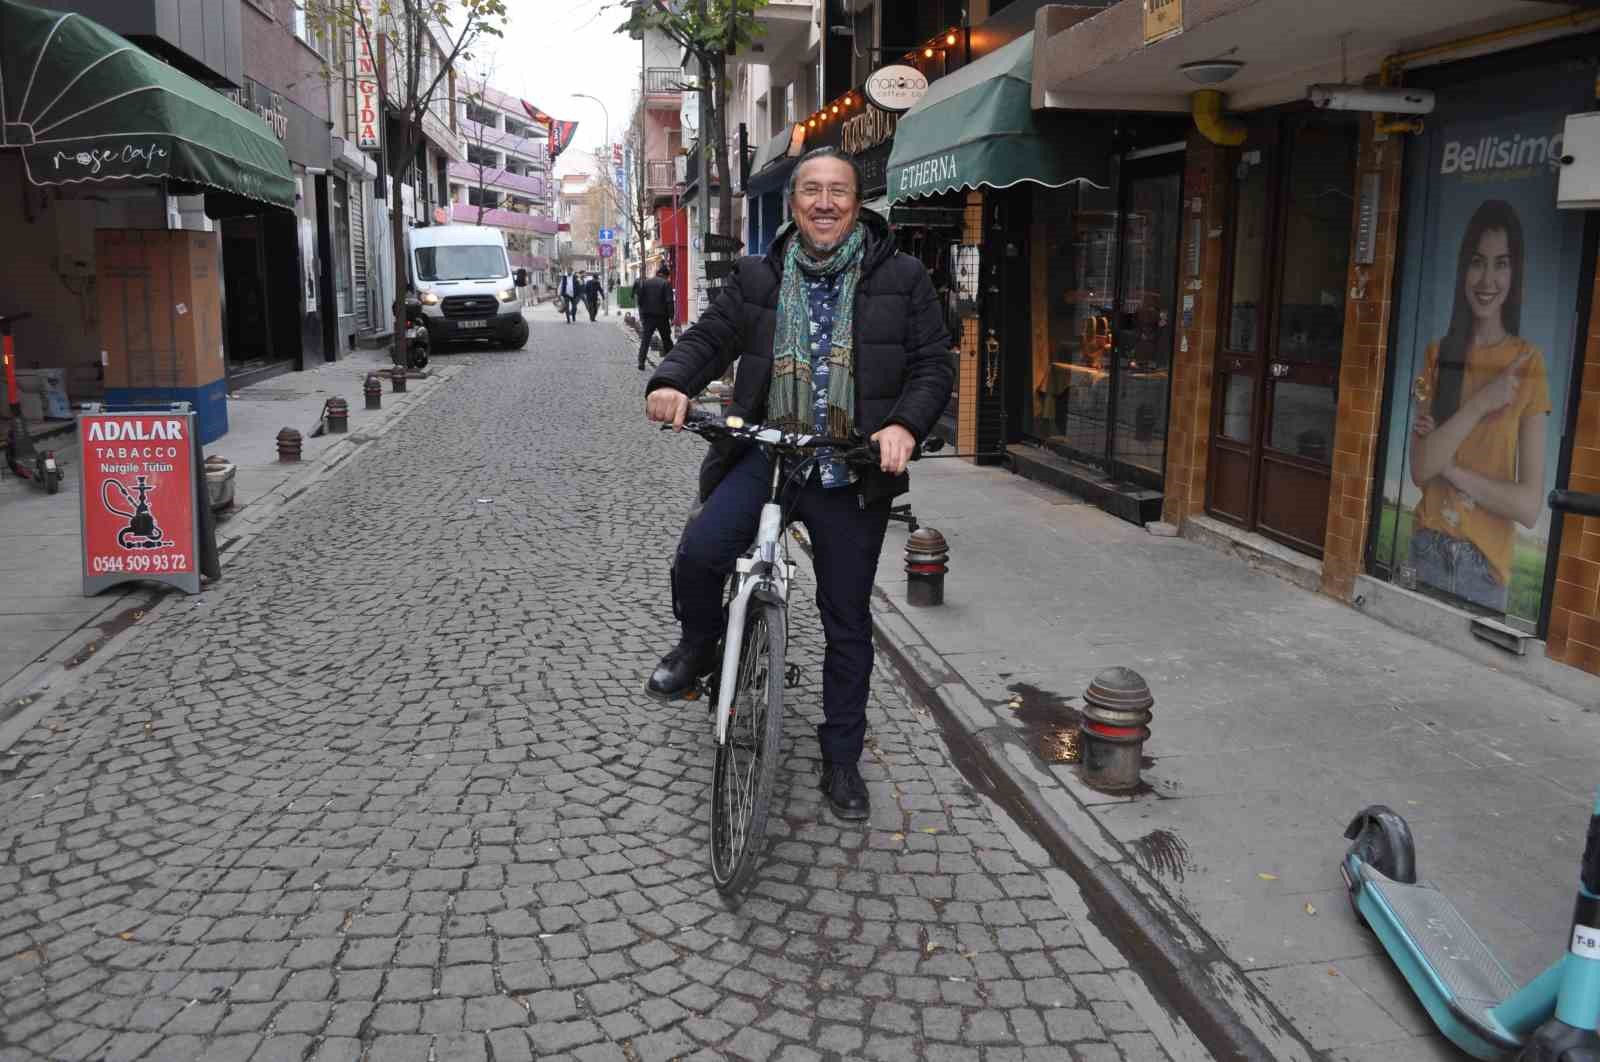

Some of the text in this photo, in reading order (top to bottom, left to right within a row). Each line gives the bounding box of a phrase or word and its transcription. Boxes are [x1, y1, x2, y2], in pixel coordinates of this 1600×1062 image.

[358, 80, 376, 138] GIDA
[899, 154, 958, 191] ETHERNA
[88, 420, 183, 441] ADALAR
[96, 447, 178, 458] TABACCO
[101, 463, 140, 476] Nargile
[93, 554, 187, 572] 0544 509 93 72
